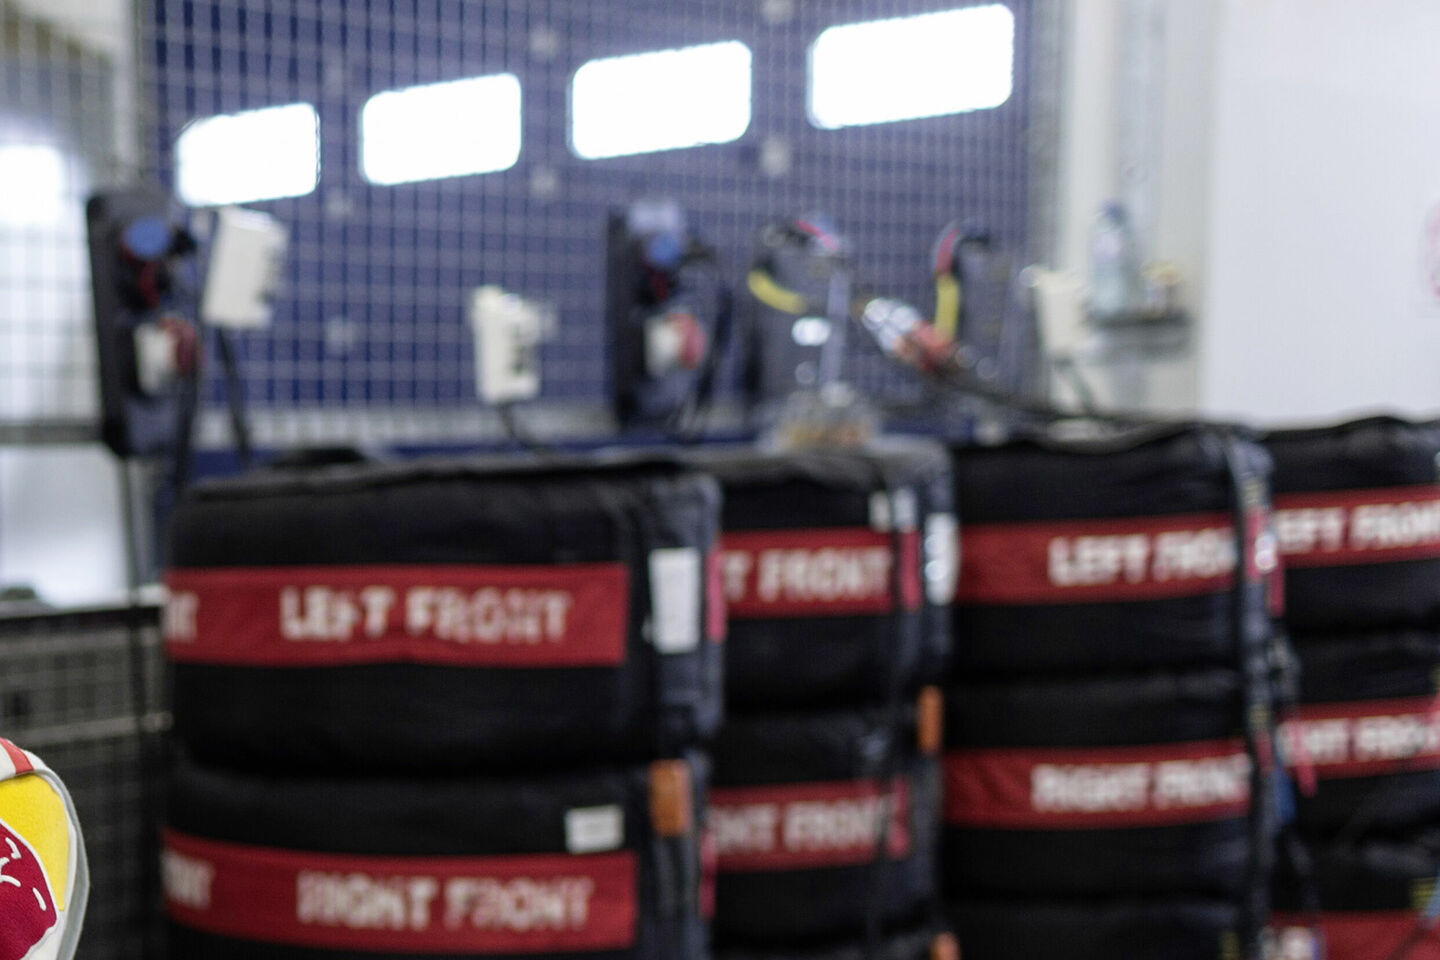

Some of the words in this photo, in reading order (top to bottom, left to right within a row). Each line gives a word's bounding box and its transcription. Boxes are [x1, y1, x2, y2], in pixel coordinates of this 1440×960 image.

[758, 546, 893, 602] FRONT
[1048, 534, 1148, 587] LEFT
[279, 585, 394, 641] LEFT
[405, 586, 570, 644] FRONT
[1031, 763, 1151, 812] RIGHT
[296, 870, 437, 931] RIGHT
[445, 876, 594, 932] FRONT
